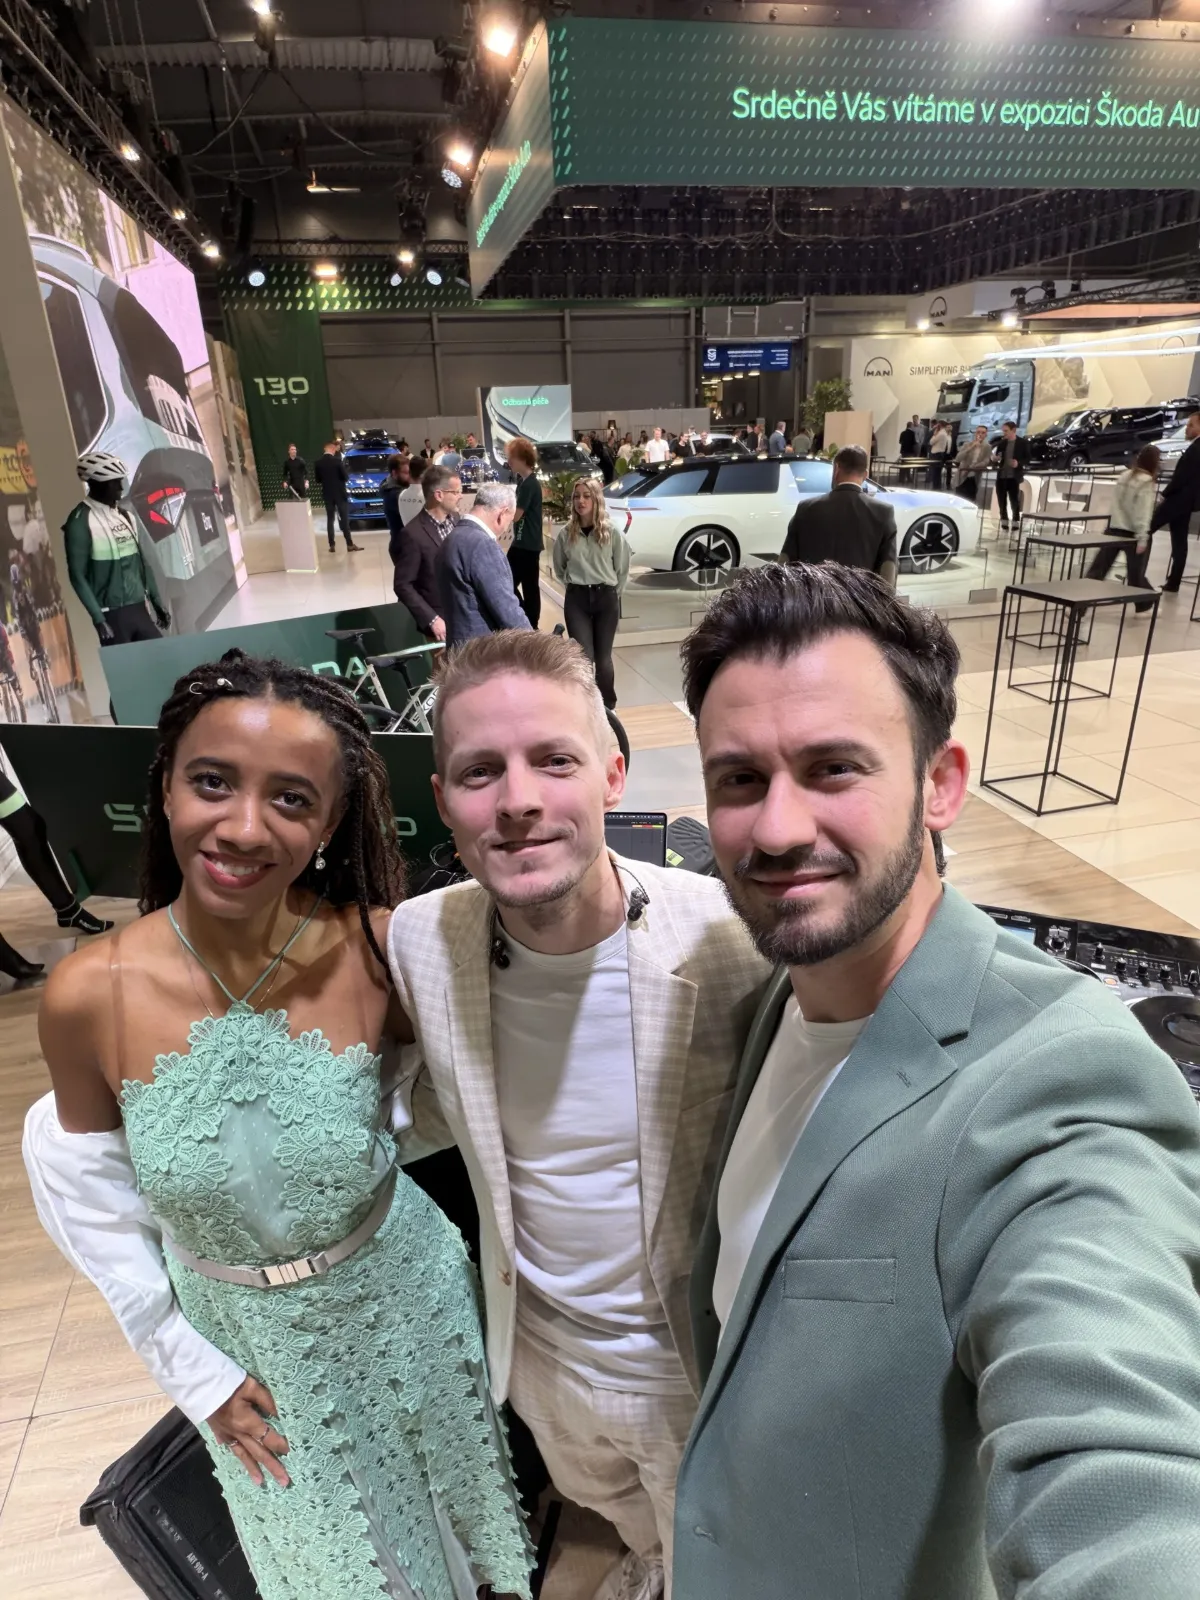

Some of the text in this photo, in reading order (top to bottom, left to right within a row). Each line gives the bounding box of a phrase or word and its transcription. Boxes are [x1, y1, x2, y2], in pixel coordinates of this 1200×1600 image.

[732, 87, 1200, 131] Srdečně Vás vítáme v expozici Škoda Au
[909, 365, 958, 376] SIMPLIFYING
[253, 376, 310, 396] 130
[272, 397, 298, 405] LET
